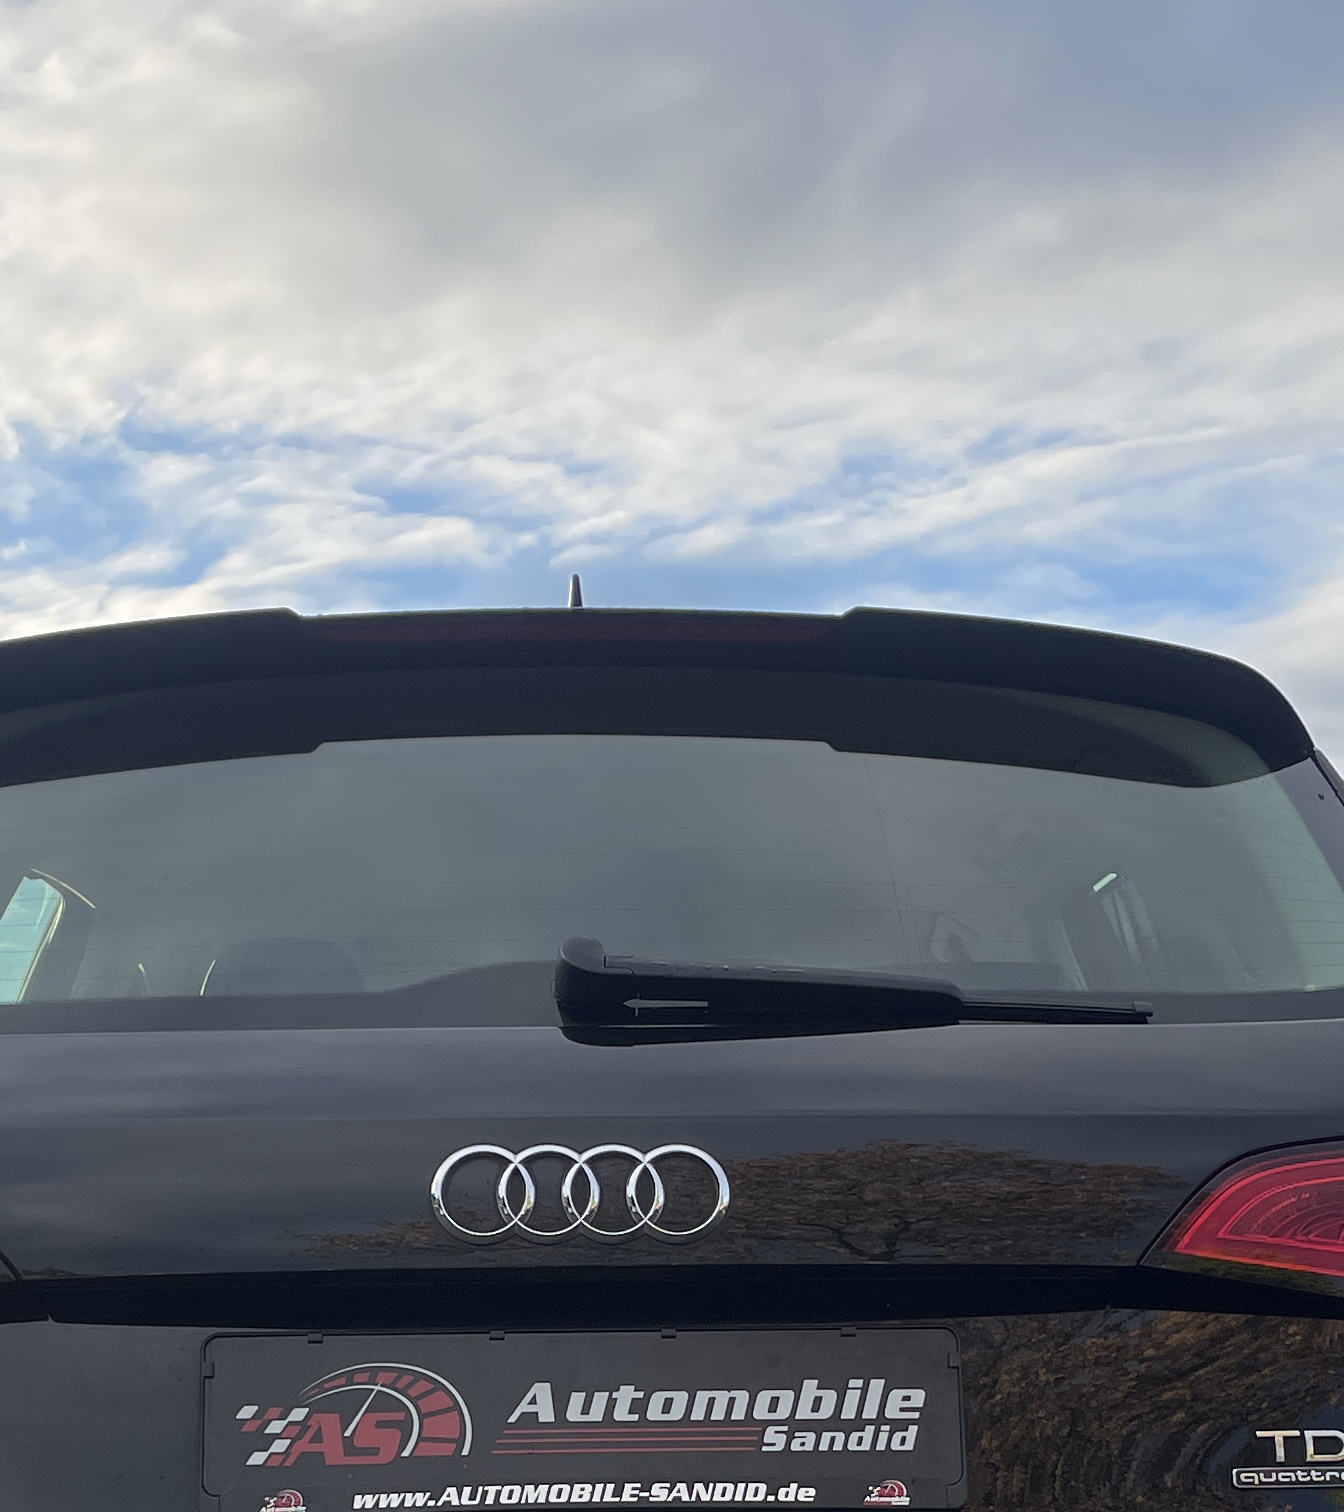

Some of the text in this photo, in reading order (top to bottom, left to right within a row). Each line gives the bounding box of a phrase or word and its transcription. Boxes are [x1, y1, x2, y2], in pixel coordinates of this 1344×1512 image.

[506, 1378, 926, 1423] Automobile
[760, 1424, 920, 1452] Sandid
[352, 1481, 817, 1510] www.AUTOMOBILE-SANDID.de
